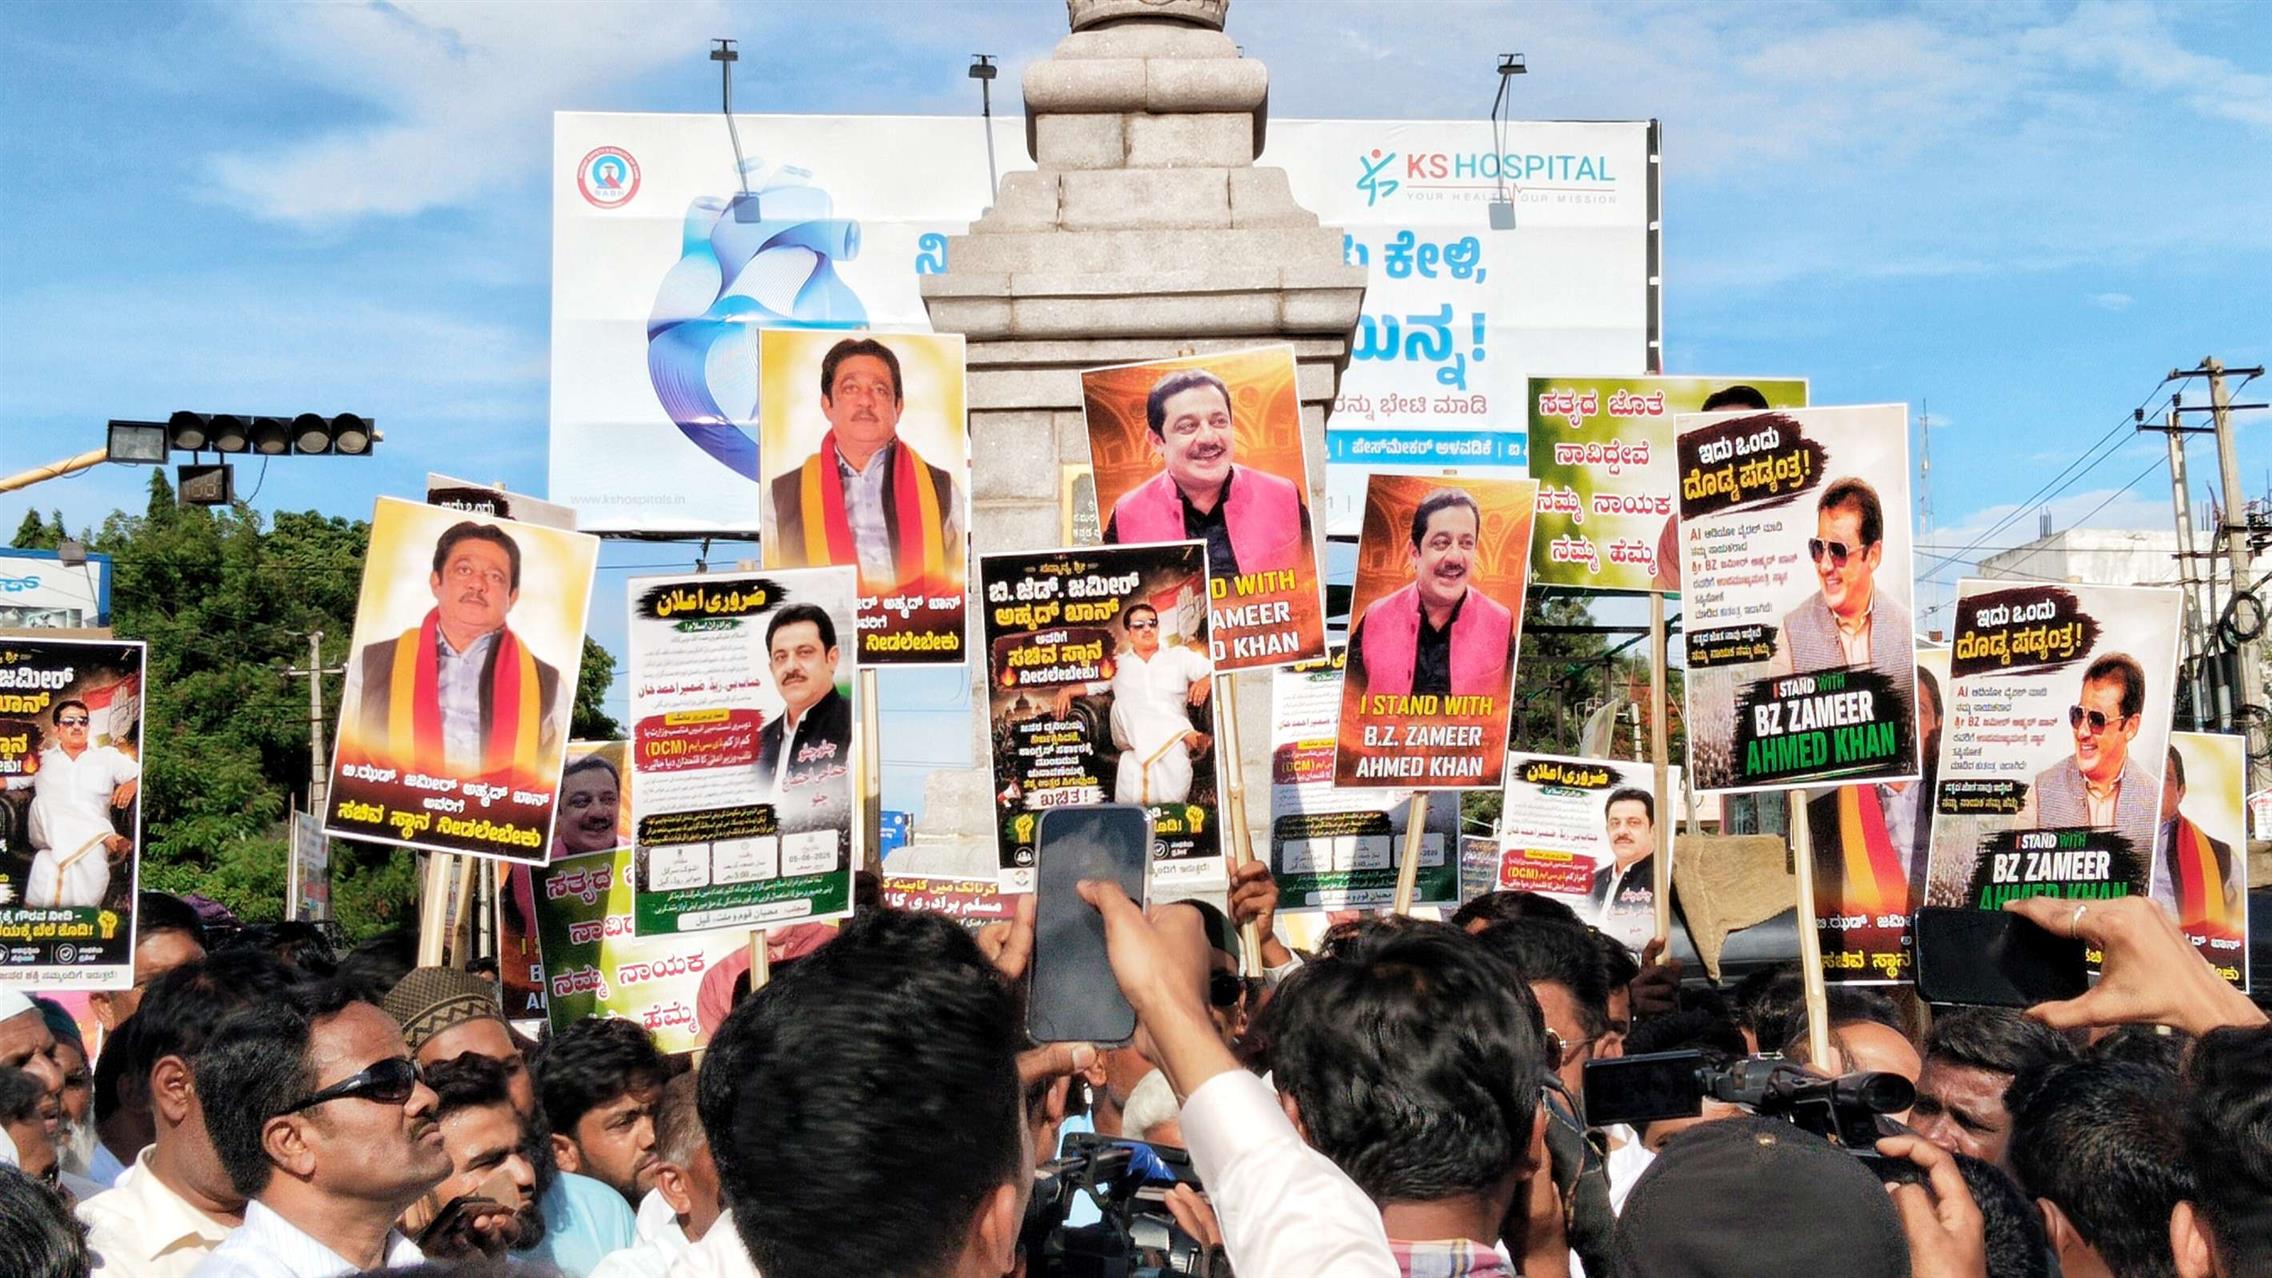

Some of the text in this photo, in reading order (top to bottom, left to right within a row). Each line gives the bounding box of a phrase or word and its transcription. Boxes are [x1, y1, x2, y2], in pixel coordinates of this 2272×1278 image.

[1407, 154, 1616, 181] KS HOSPITAL
[1407, 192, 1443, 200] YOUR
[1521, 194, 1548, 202] OUR
[1557, 195, 1616, 204] MISSION
[1384, 230, 1486, 283] ಕೇಳಿ,
[1380, 393, 1426, 417] ಭೇಟಿ
[1433, 395, 1488, 414] ಮಾಡಿ
[1540, 390, 1664, 426] ಸತ್ಯದ ಜೊತೆ
[1556, 440, 1650, 475] ನಾವಿದ್ದೇವೆ
[1698, 426, 1780, 464] ಇದು ಒಂದು
[1684, 463, 1739, 502] ದೊಡ್ಡ
[570, 495, 685, 506] www.kshospitals.in
[1537, 488, 1671, 522] ನಮ್ಮ ನಾಯಕ
[1552, 536, 1657, 575] ನಮ್ಮ ಹೆಮ್ಮೆ
[1705, 559, 1717, 571] BZ
[1068, 571, 1140, 598] ಜಮೀರ್
[1234, 568, 1296, 597] WITH
[656, 585, 766, 617] ضروری اعلان
[883, 593, 924, 619] ಅಹ್ಮದ್
[928, 595, 961, 610] ಖಾನ್
[995, 598, 1120, 631] ಅಹ್ಮದ್ ಖಾನ್
[1976, 598, 2056, 627] ಇದು ಒಂದು
[857, 615, 888, 629] ವರಿಗೆ
[1211, 601, 1291, 631] AMEER
[866, 630, 959, 651] ನೀಡಲೇಬೇಕು
[1035, 631, 1067, 645] ಅವರಿಗೆ
[1233, 631, 1300, 659] KHAN
[1957, 628, 2010, 664] ದೊಡ್ಡ
[1008, 640, 1103, 668] ಸಚಿವ ಸ್ಥಾನ
[1772, 674, 1845, 699] I STAND WITH
[1359, 694, 1368, 715] I
[1372, 694, 1439, 716] STAND
[1444, 695, 1494, 716] WITH
[1754, 690, 1875, 737] BZ ZAMEER
[645, 739, 688, 757] (DCM)
[1363, 725, 1483, 747] B.Z. ZAMEER
[1746, 722, 1896, 776] AHMED KHAN
[1355, 756, 1484, 778] AHMED KHAN
[404, 773, 457, 791] ಜಮೀರ್
[463, 782, 508, 807] ಅಹ್ಮದ್
[513, 790, 550, 808] ಖಾನ್
[423, 796, 465, 813] ಅವರಿಗೆ
[338, 800, 541, 848] ಸಚಿವ ಸ್ಥಾನ ನೀಡಲೇಬೇಕು
[2015, 832, 2087, 850] I STAND WITH
[1508, 867, 1538, 879] (DCM)
[1993, 851, 2111, 883] BZ ZAMEER
[547, 865, 612, 904] ಸತ್ಯದ
[554, 968, 609, 998] ನಮ್ಮ
[619, 951, 706, 984] ನಾಯಕ
[1871, 949, 1911, 978] ಸ್ಥಾನ
[643, 1001, 698, 1033] ಹೆಮ್ಮೆ
